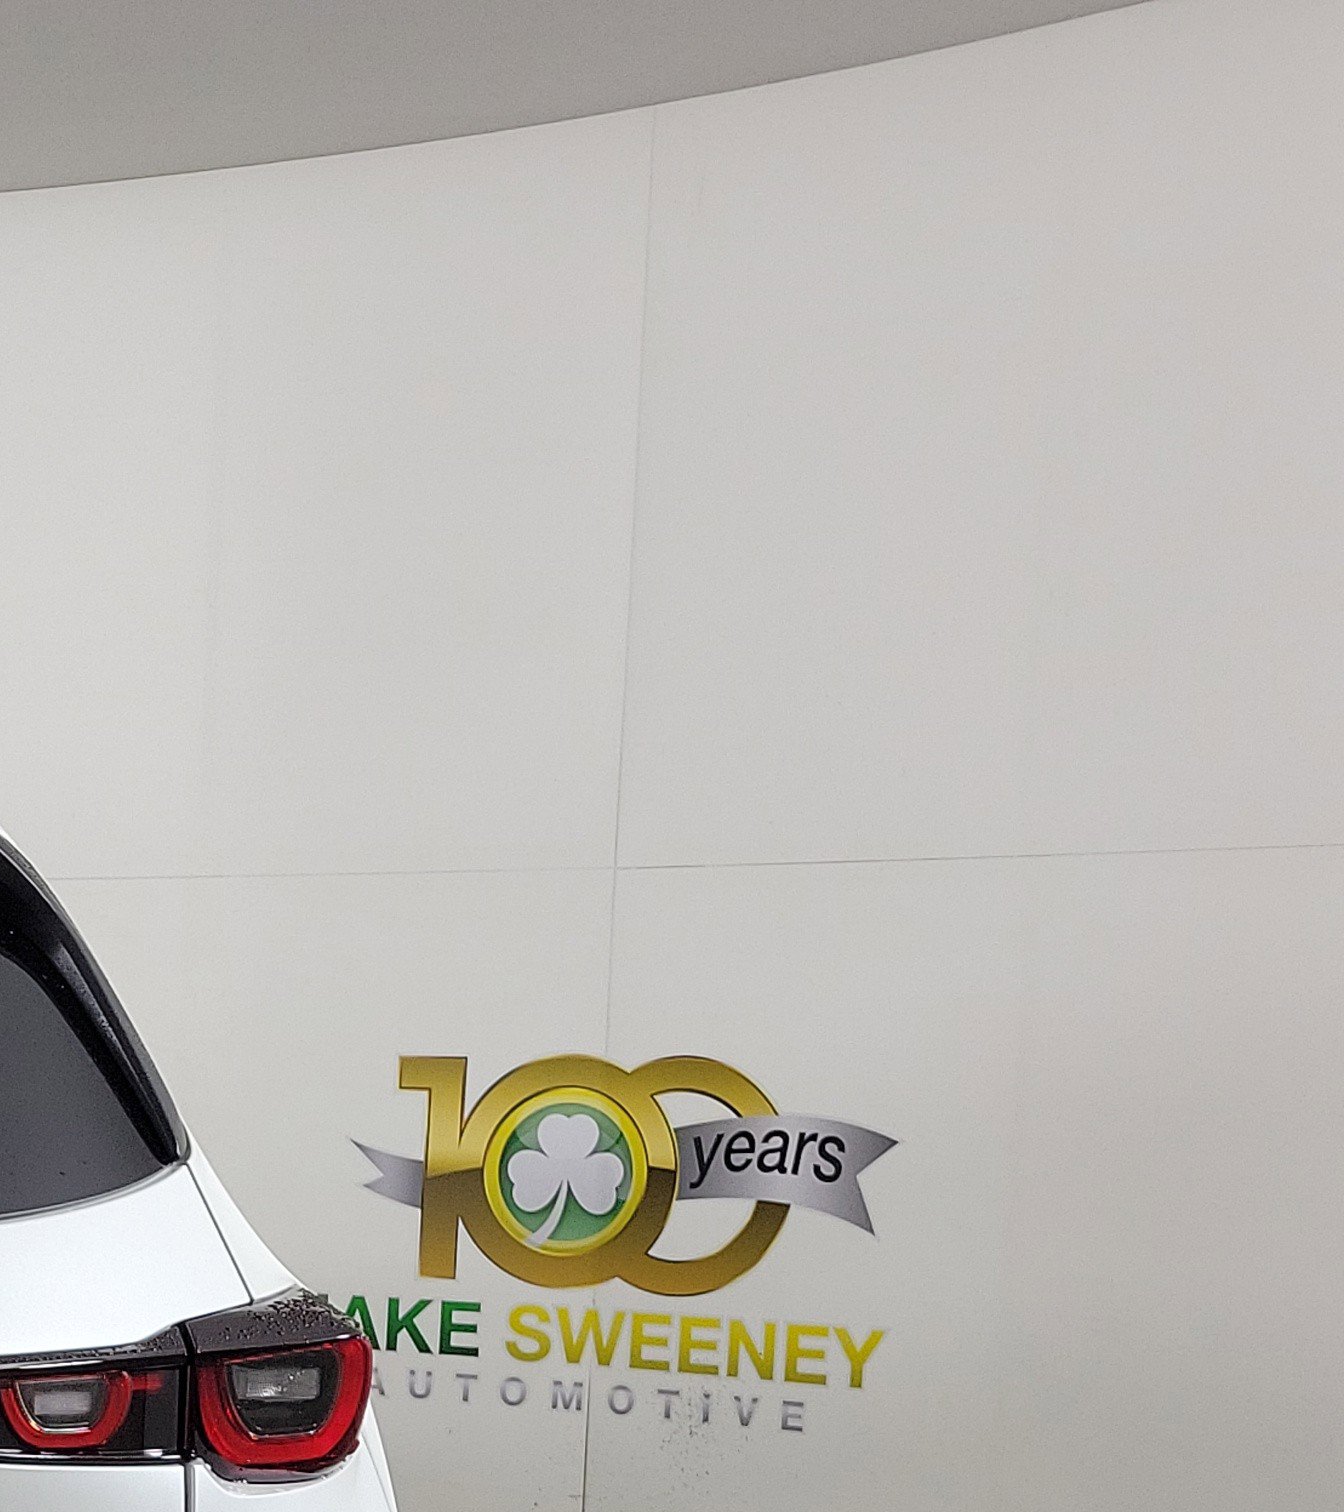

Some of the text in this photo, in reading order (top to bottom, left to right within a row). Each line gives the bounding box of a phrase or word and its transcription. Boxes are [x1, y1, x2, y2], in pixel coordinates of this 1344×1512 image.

[398, 1053, 792, 1297] 100
[688, 1128, 848, 1190] years
[318, 1294, 885, 1389] AKE SWEENEY
